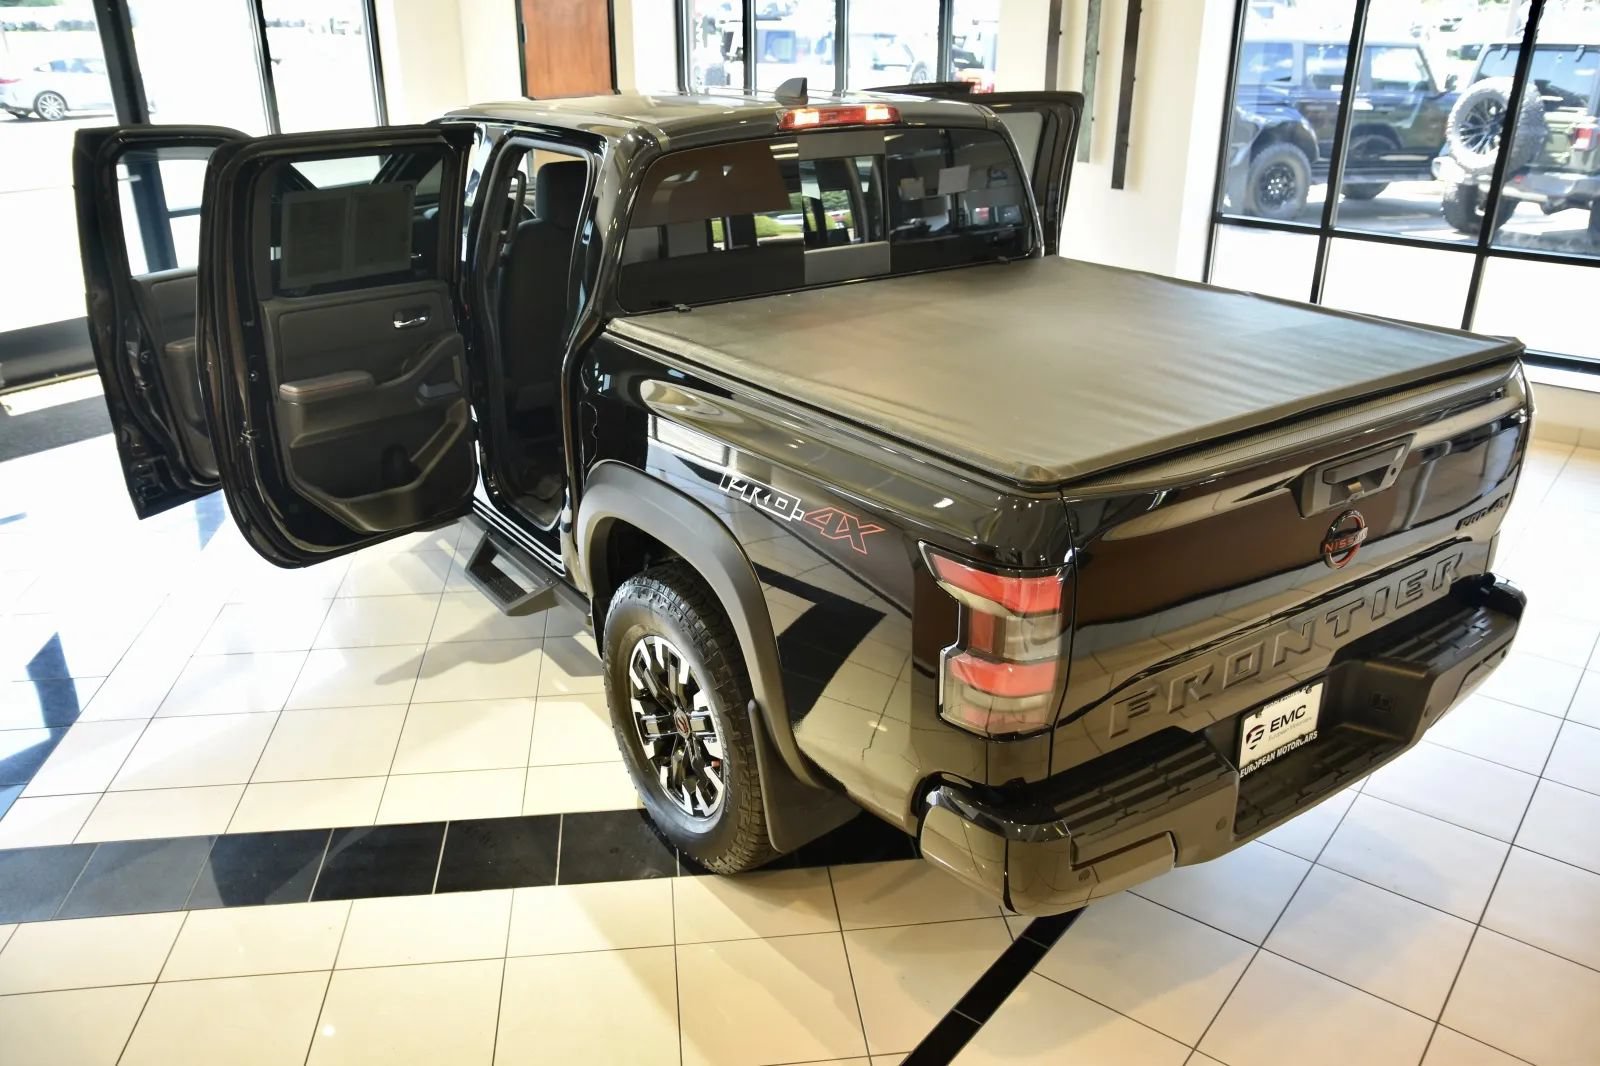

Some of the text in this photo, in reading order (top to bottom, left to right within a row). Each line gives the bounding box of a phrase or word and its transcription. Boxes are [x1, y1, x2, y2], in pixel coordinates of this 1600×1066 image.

[1109, 552, 1463, 739] FRONTIER
[1270, 704, 1307, 733] EMC
[1240, 751, 1276, 778] EUROPEAN
